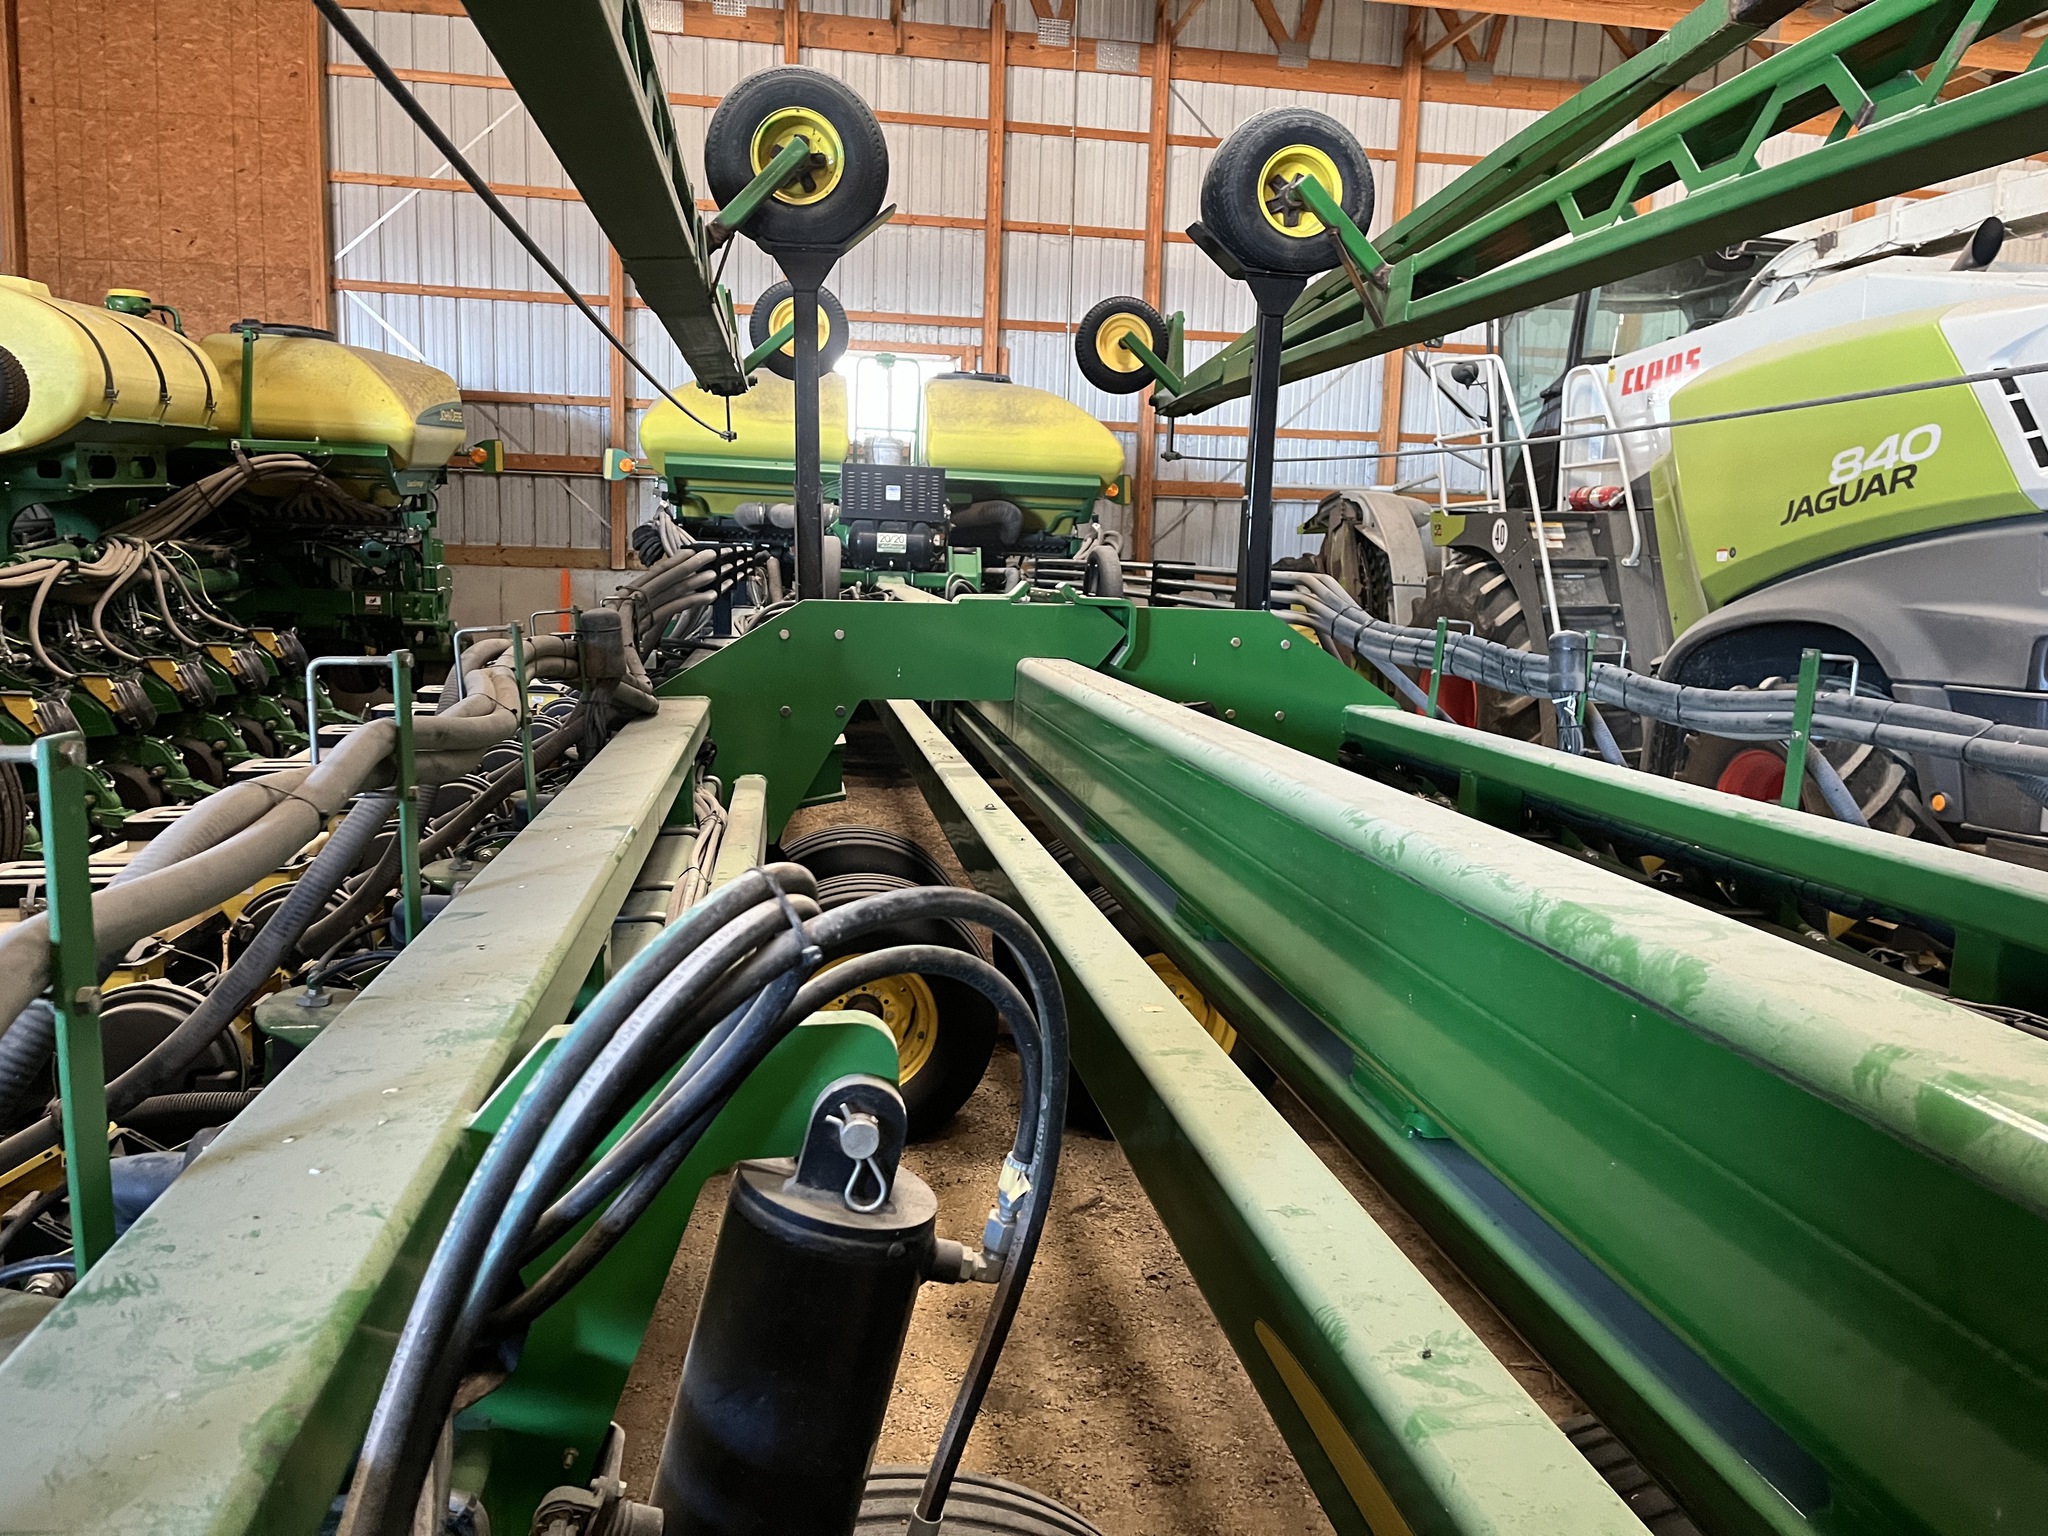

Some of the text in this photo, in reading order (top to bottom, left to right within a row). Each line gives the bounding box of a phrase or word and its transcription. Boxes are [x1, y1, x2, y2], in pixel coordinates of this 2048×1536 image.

[1621, 346, 1702, 397] CLAAS
[1828, 423, 1942, 486] 840
[1780, 464, 1918, 526] JAGUAR
[879, 534, 905, 544] 20/20
[1494, 524, 1506, 546] 40
